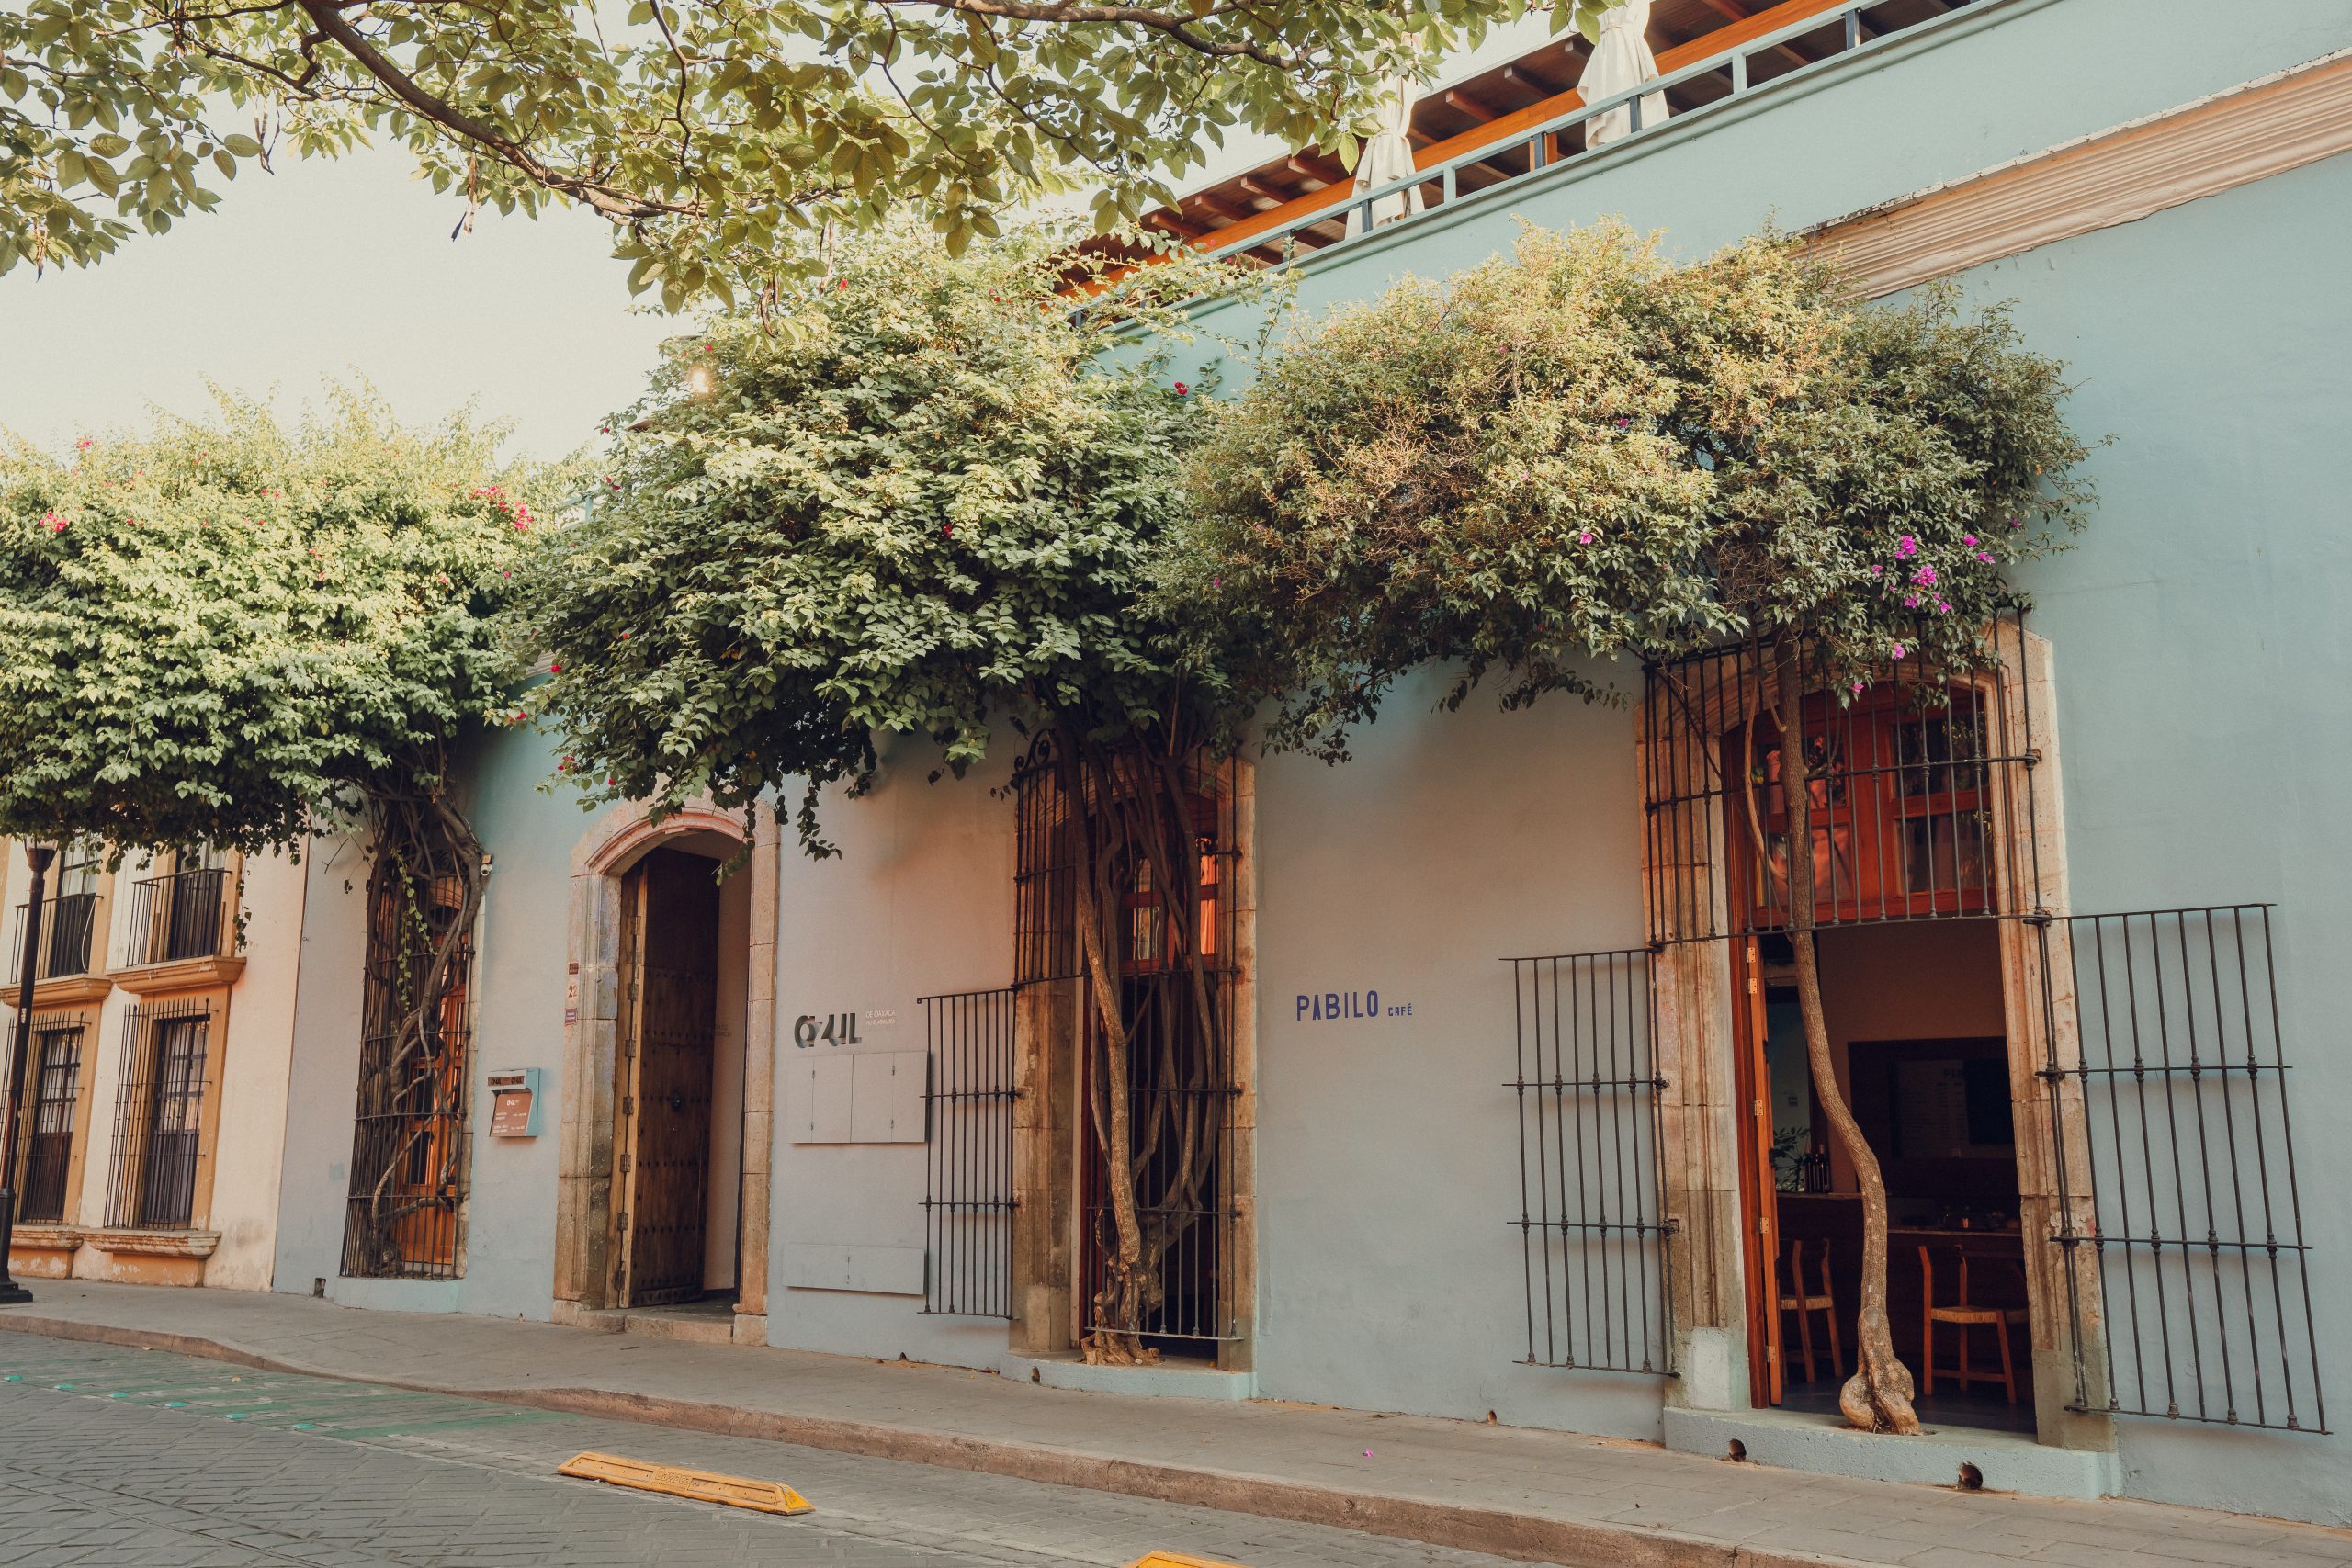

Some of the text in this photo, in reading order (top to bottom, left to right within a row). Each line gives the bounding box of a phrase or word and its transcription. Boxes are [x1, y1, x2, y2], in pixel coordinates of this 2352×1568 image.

[568, 985, 578, 998] 22
[1296, 989, 1412, 1021] PABILO CAFÉ
